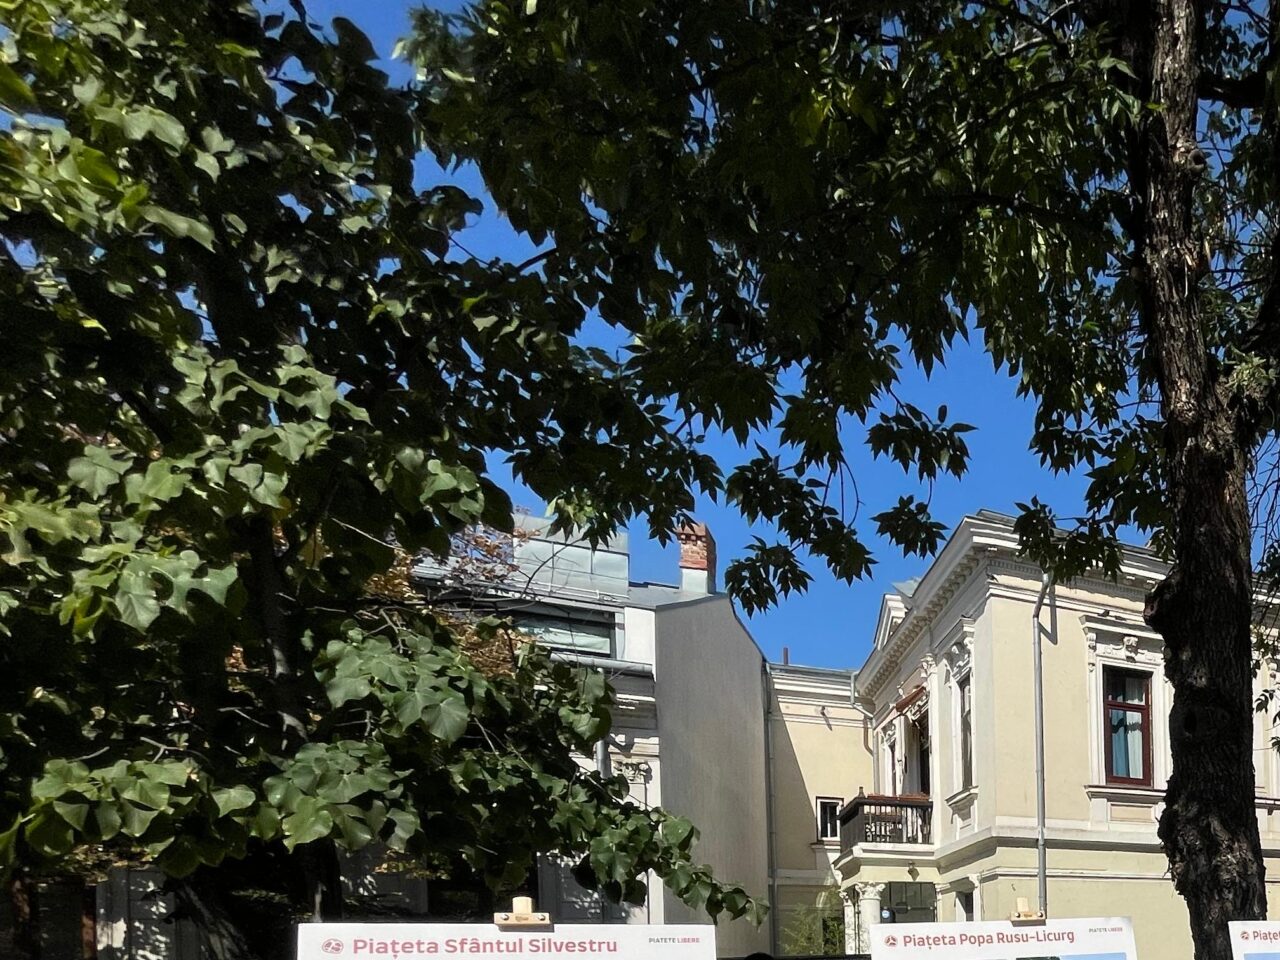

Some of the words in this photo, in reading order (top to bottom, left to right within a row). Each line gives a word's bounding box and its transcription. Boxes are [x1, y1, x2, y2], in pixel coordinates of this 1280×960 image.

[353, 938, 439, 959] Piațeta
[444, 937, 523, 953] Sfântul
[528, 937, 618, 953] Silvestru
[903, 934, 956, 950] Piațeta
[959, 933, 994, 947] Popa
[997, 930, 1075, 944] Rusu-Licurg
